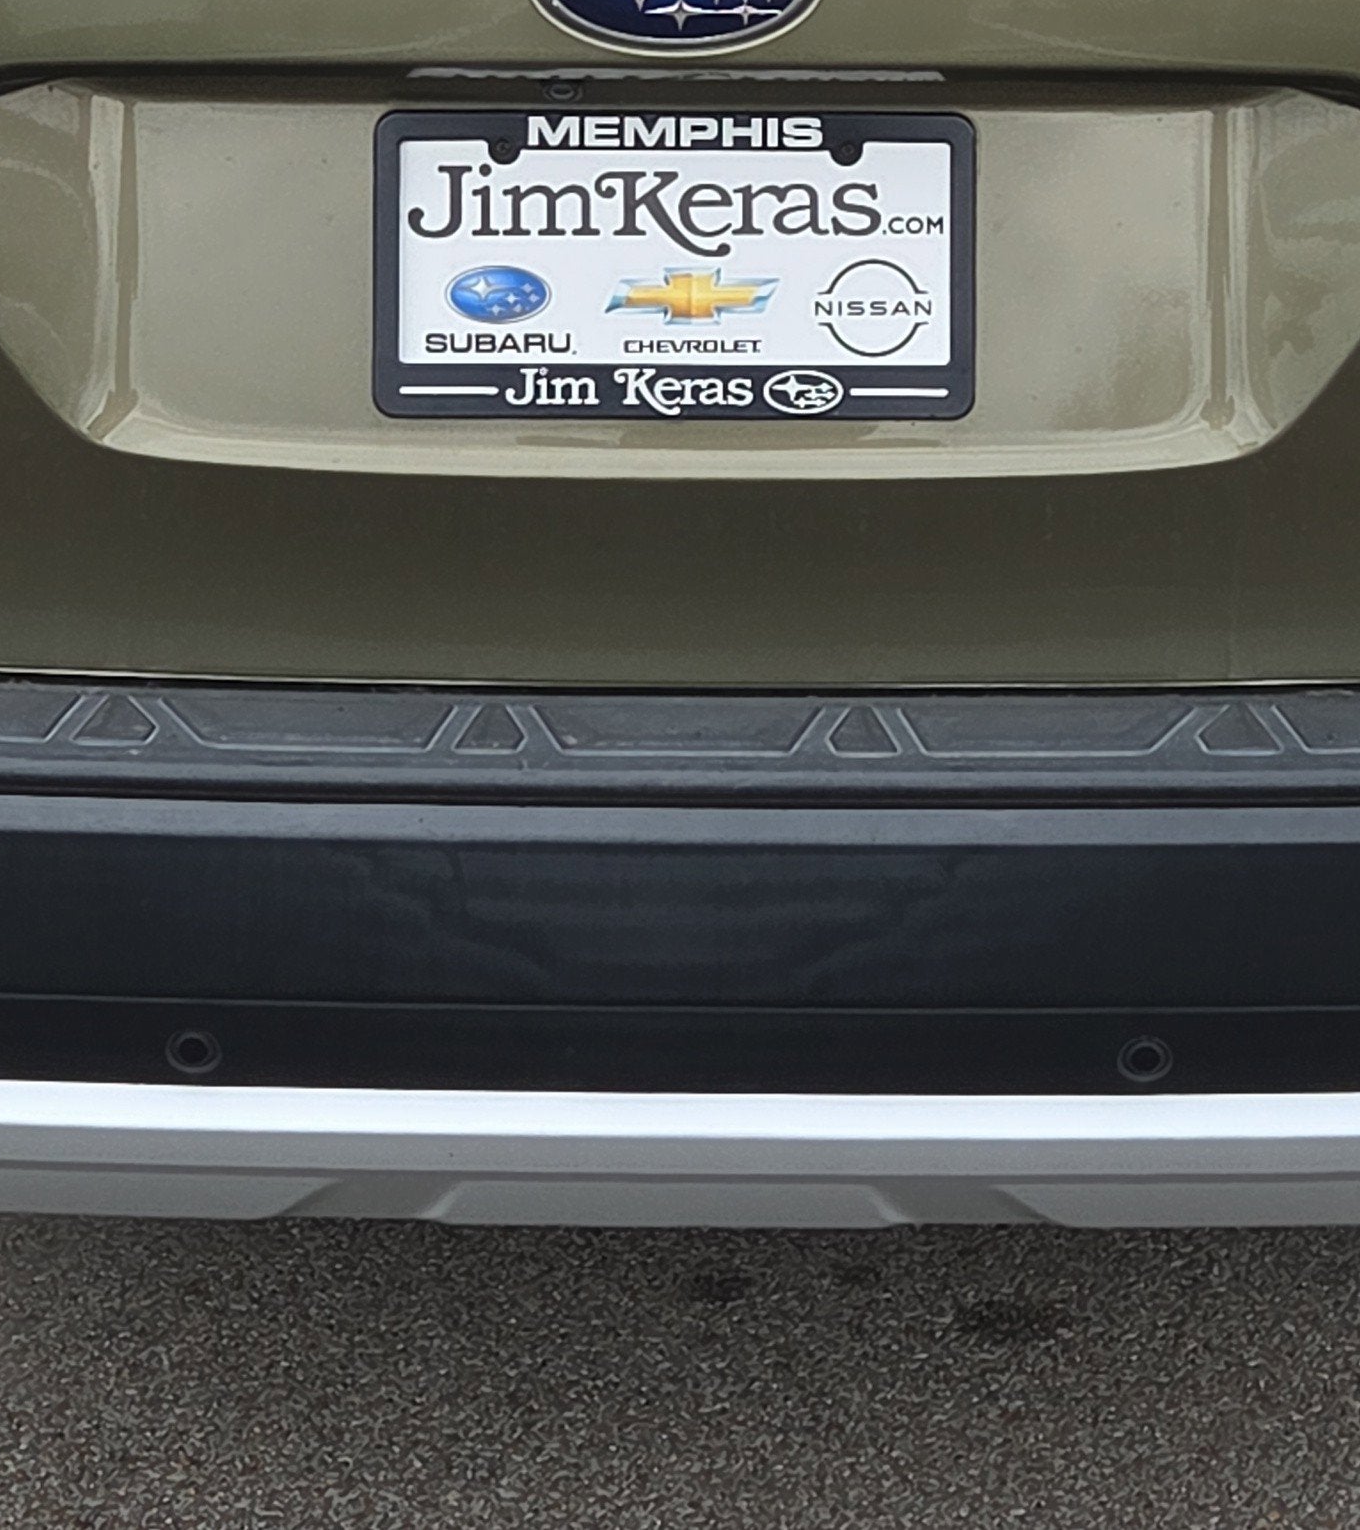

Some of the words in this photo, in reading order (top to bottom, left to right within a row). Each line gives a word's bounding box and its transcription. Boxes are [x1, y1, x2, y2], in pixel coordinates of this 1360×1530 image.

[527, 116, 823, 148] MEMPHIS
[813, 298, 933, 317] NISSAN
[425, 332, 572, 355] SUBARU
[623, 339, 762, 354] CHEVROLET
[504, 367, 600, 406] Jim
[613, 368, 755, 416] Keras
